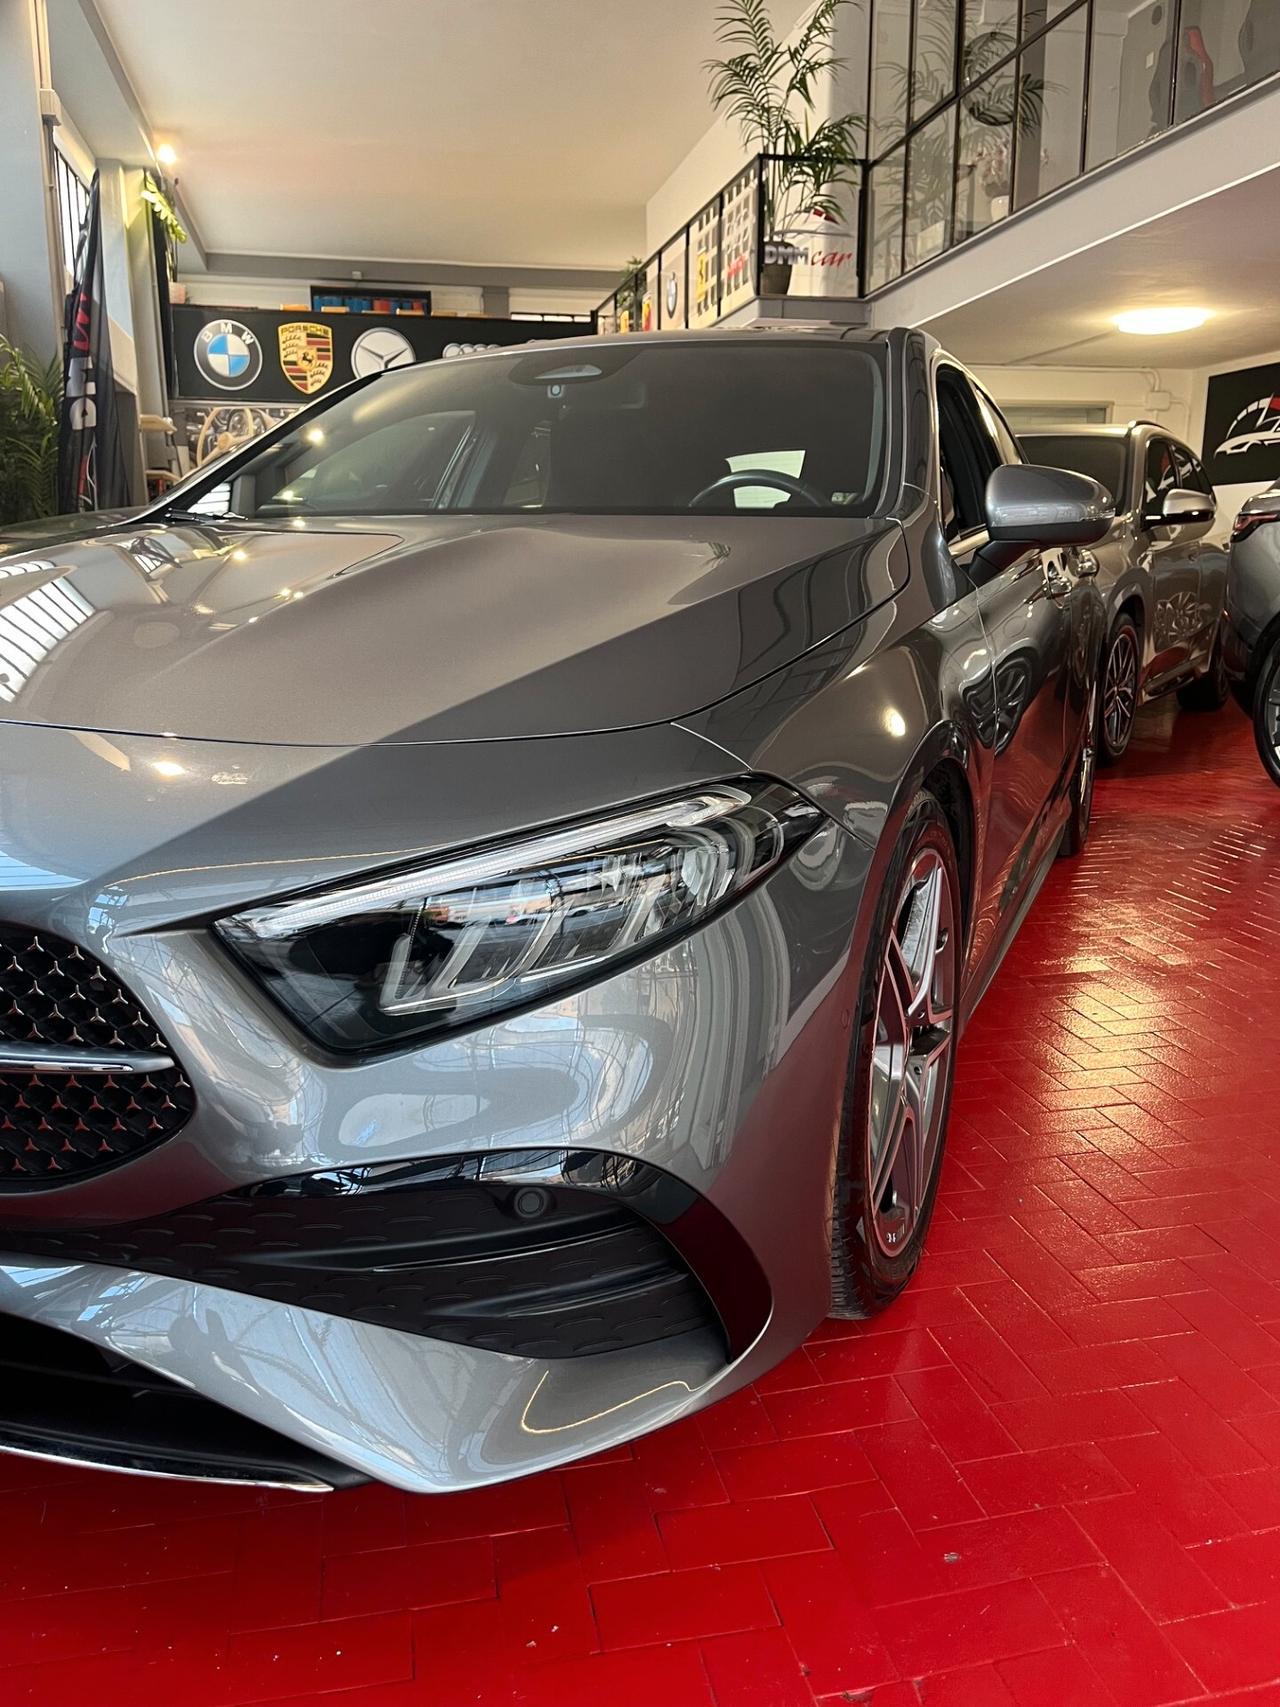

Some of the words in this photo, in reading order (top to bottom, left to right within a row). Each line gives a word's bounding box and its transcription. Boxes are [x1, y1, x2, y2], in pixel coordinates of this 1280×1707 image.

[764, 245, 809, 265] DMM
[811, 250, 853, 268] car
[201, 322, 255, 345] BMW
[280, 324, 330, 335] PORSCHE
